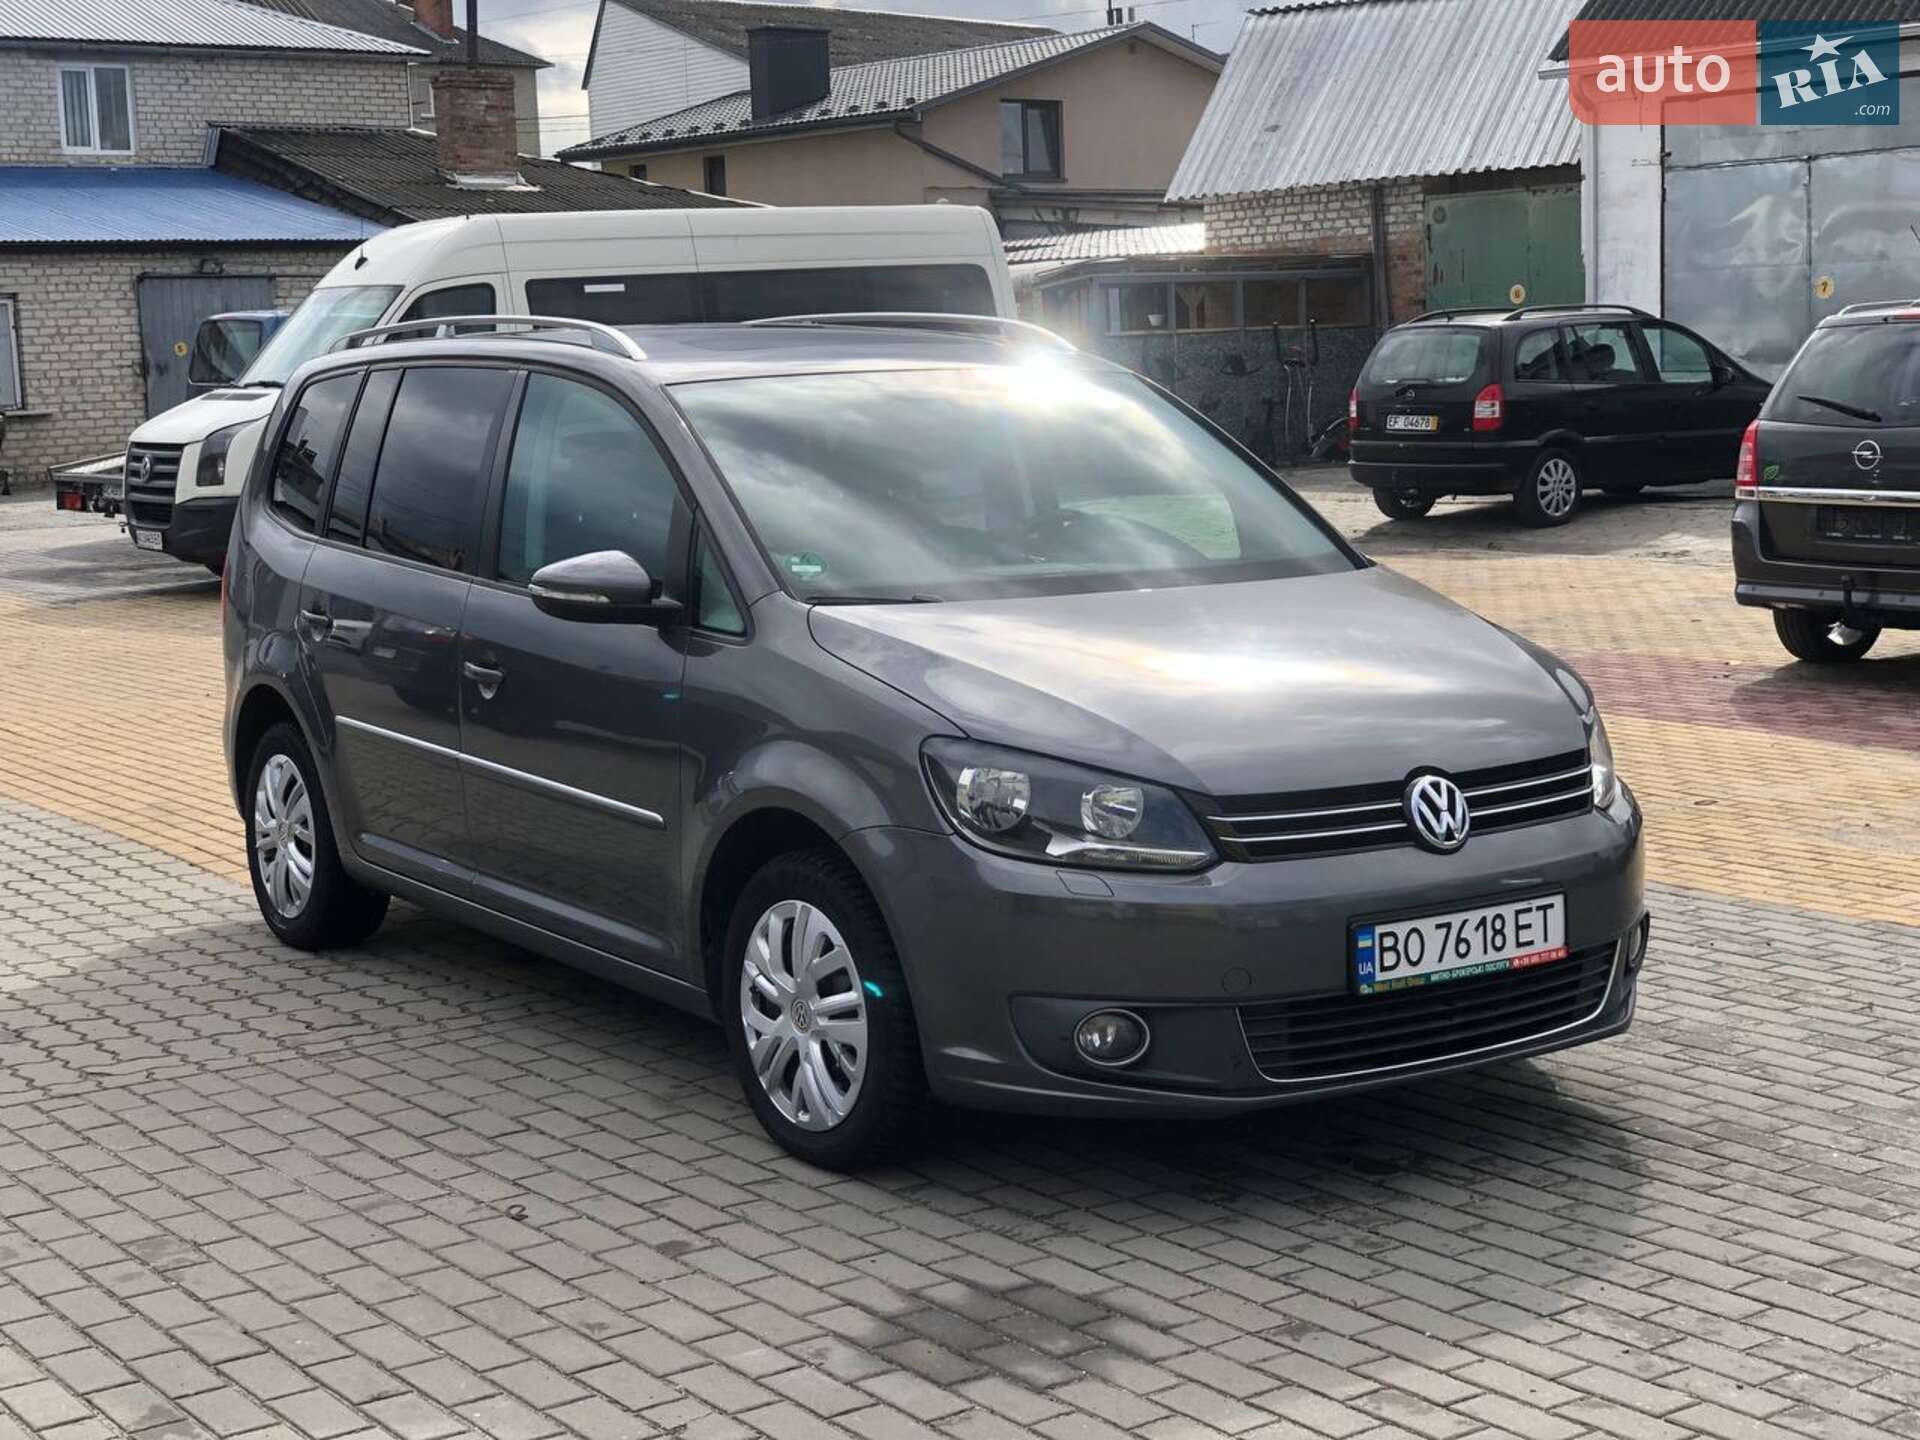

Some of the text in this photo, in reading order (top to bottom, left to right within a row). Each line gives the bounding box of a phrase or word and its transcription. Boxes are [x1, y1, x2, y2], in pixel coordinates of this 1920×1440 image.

[1378, 926, 1426, 973] BO
[1435, 912, 1507, 964] 7618
[1514, 902, 1555, 949] ET
[1358, 962, 1374, 975] UA
